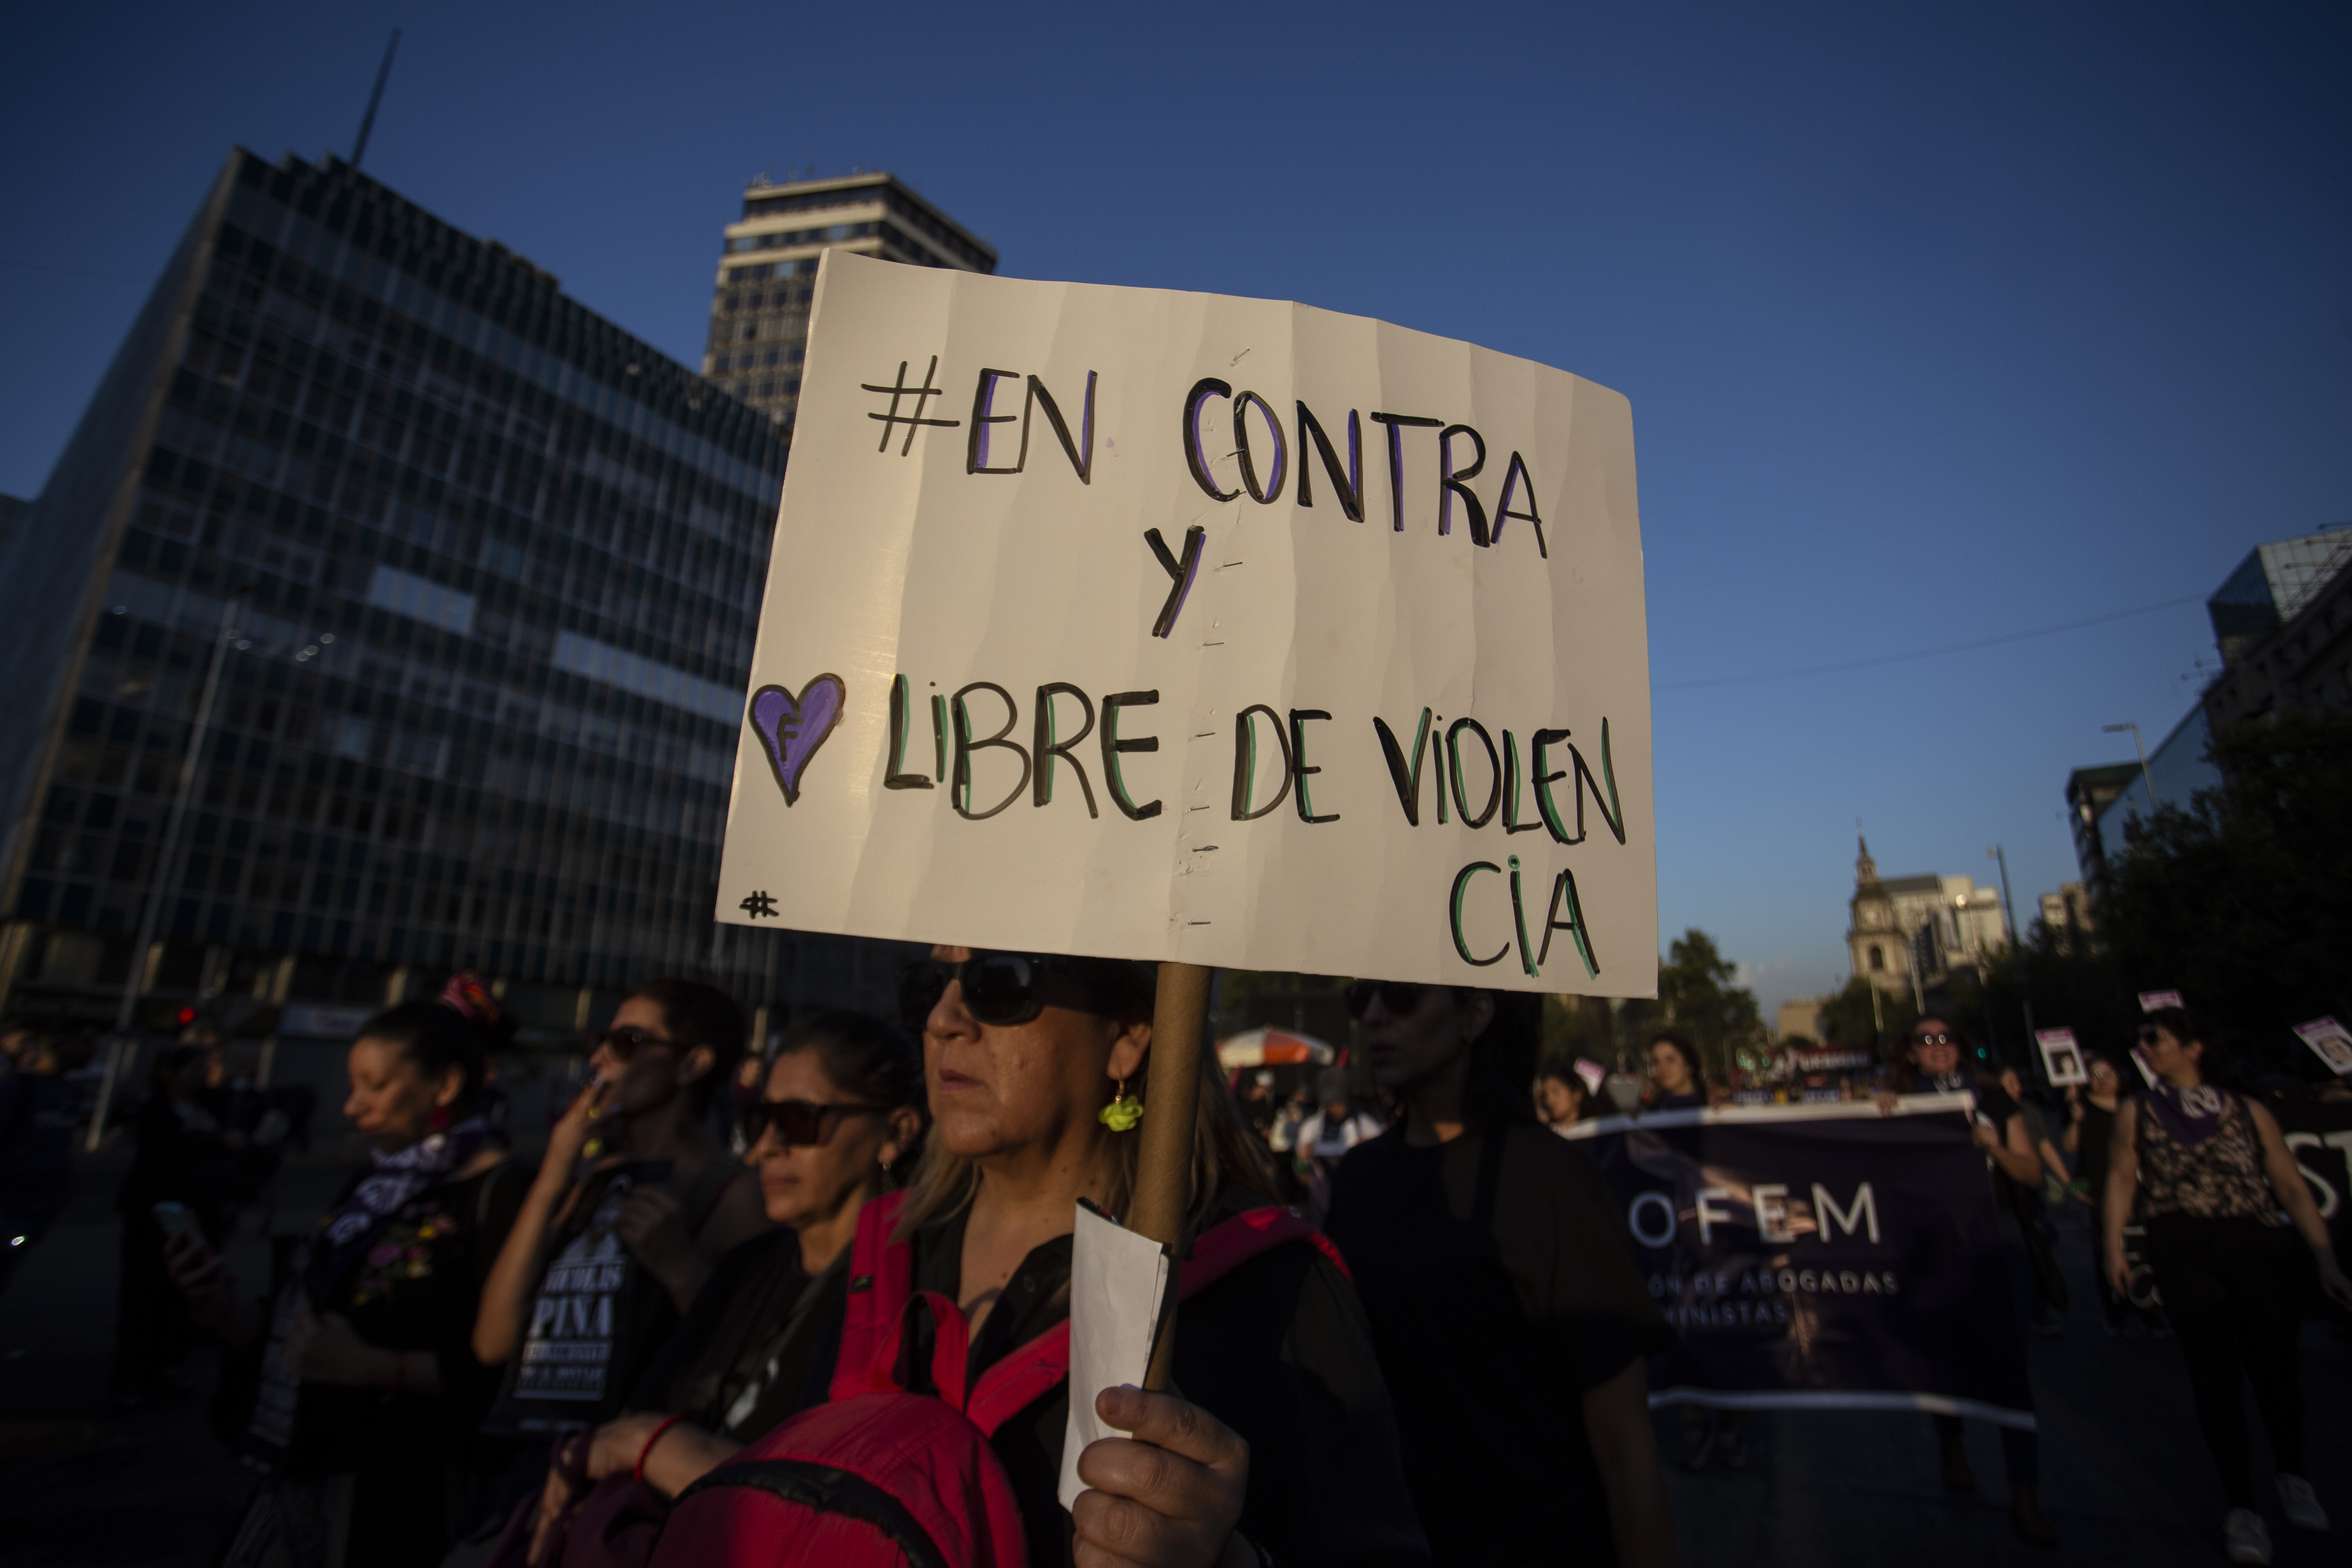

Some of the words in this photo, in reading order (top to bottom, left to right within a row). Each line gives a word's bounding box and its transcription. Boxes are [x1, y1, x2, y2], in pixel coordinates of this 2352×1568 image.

[1184, 377, 1548, 558] CONTRA
[1143, 525, 1206, 638] Y
[777, 713, 804, 762] F
[1230, 704, 1341, 823] DE
[1627, 1181, 1881, 1249] OFEM
[1693, 1270, 1731, 1296] DE
[1740, 1268, 1901, 1296] ABOGADAS
